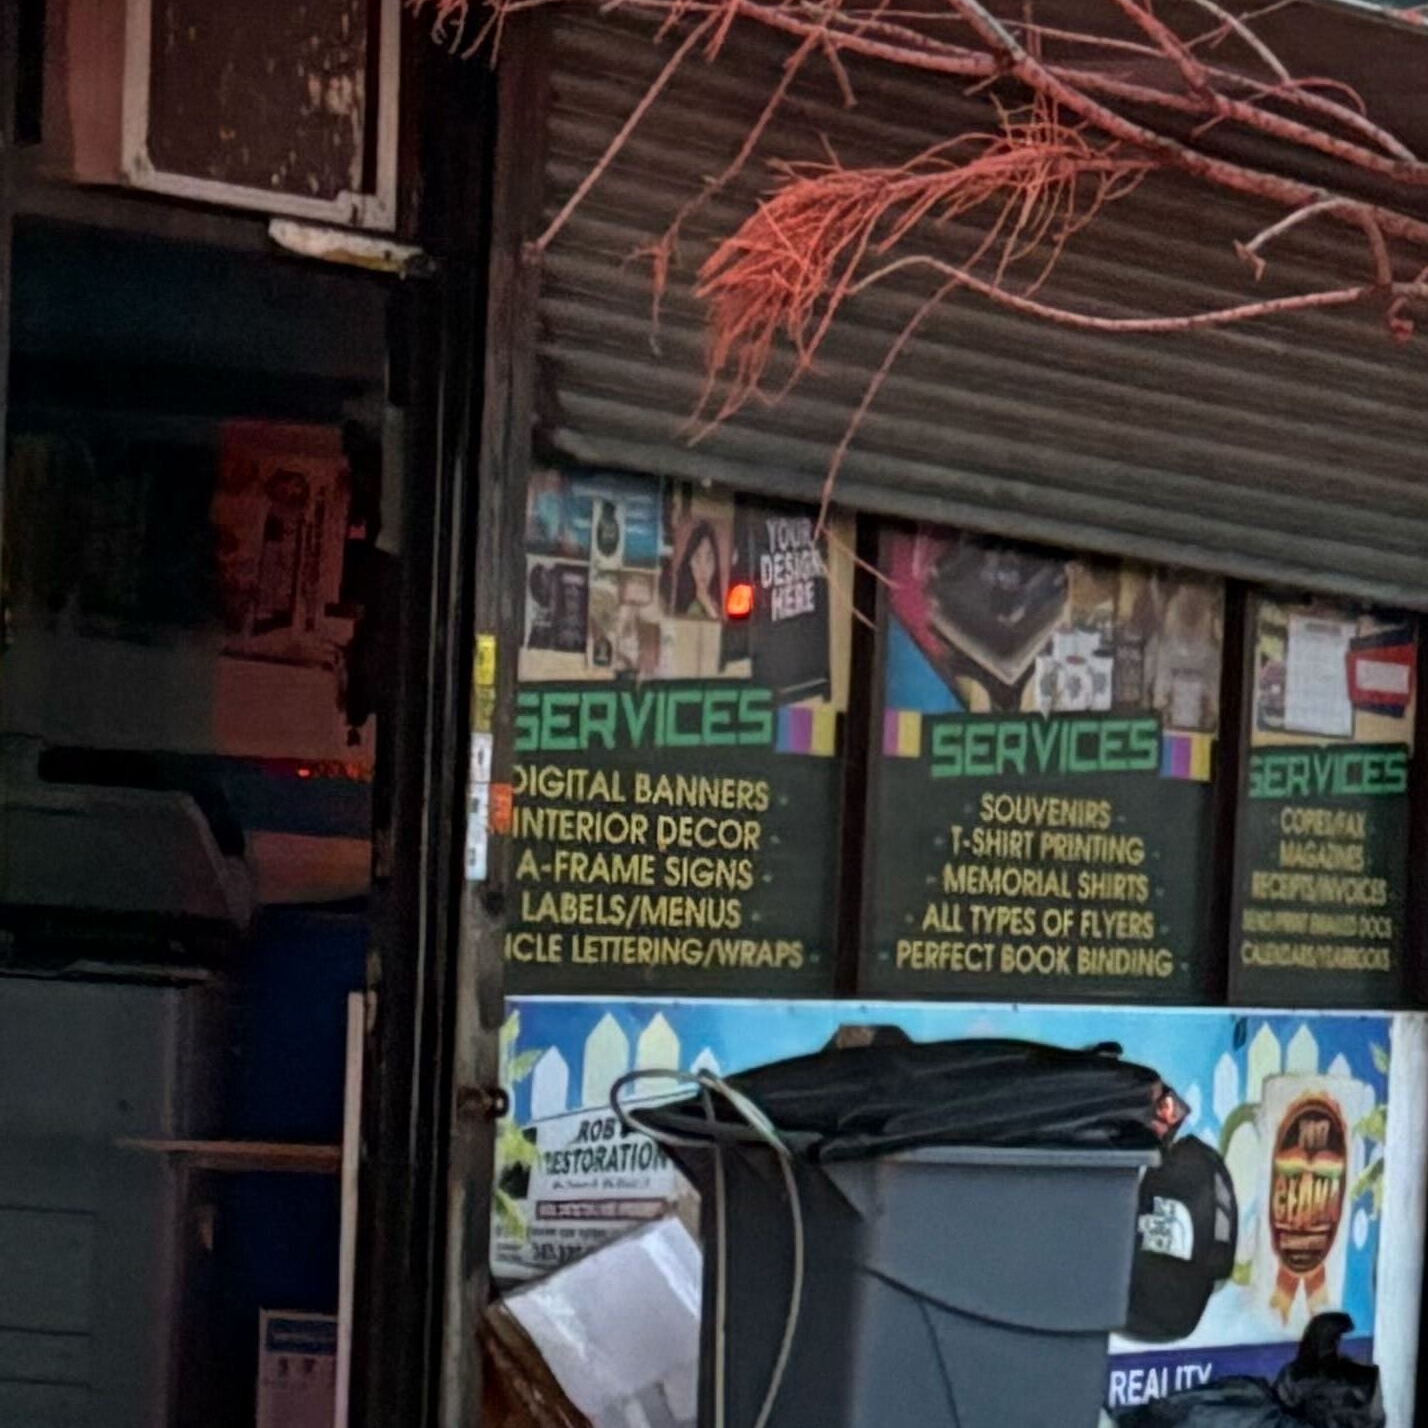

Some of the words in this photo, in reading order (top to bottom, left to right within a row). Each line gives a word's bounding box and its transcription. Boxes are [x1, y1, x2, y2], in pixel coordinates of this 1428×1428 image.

[514, 688, 773, 751] SERVICES
[931, 718, 1160, 779] SERVICES
[634, 772, 770, 812] BANNERS
[1250, 752, 1407, 800] SERVICES
[512, 806, 650, 844] INTERIOR
[657, 815, 762, 850] DECOR
[979, 793, 1112, 830] SOUVENIRS
[950, 825, 1035, 859] T-SHIRT
[1039, 831, 1146, 866] PRINTING
[515, 848, 656, 886] A-FRAME
[664, 856, 754, 891] SIGNS
[943, 863, 1072, 899] MEMORIAL
[1077, 871, 1150, 900] SHIRTS
[521, 891, 742, 930] LABELS/MENUS
[921, 903, 966, 934] ALL
[970, 905, 1038, 936] TYPES
[1042, 907, 1074, 937] OF
[1080, 909, 1156, 941] FLYERS
[571, 933, 804, 969] LETTERING/WRAPS
[895, 939, 996, 972] PERFECT
[1002, 943, 1073, 975] BOOK
[1077, 945, 1174, 979] BINDING
